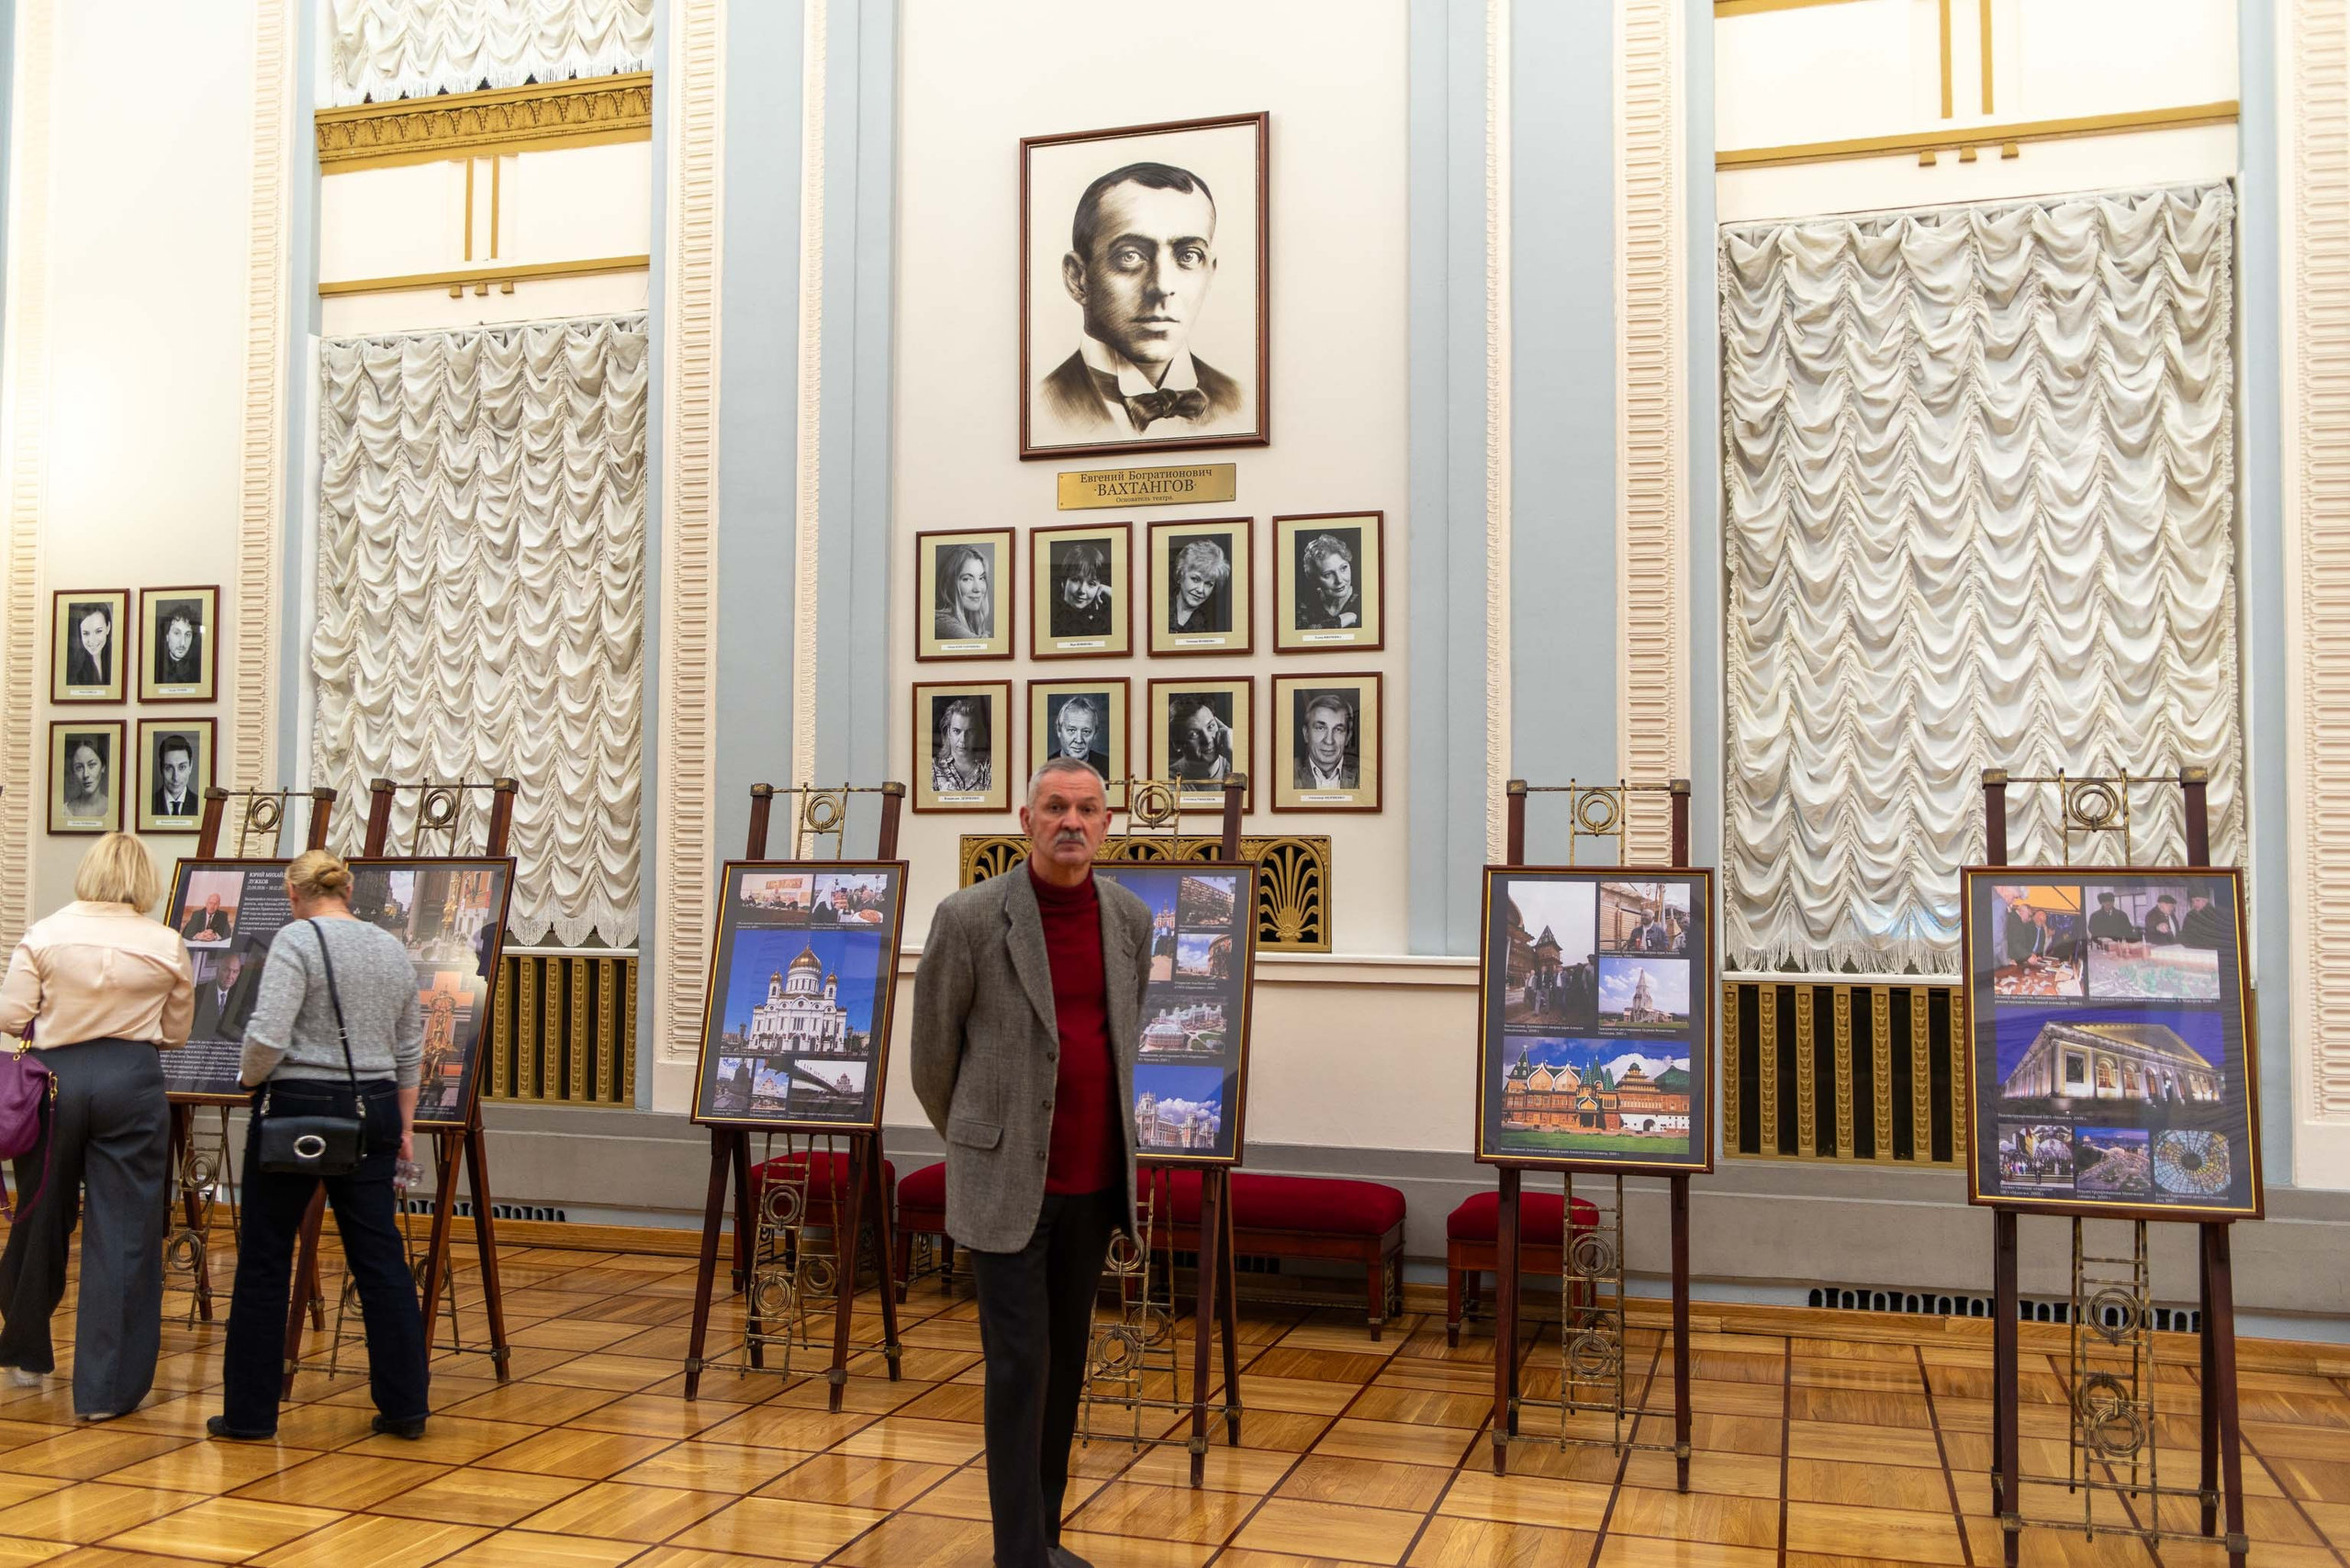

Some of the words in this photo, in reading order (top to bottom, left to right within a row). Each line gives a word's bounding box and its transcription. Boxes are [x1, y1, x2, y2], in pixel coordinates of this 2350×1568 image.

[1080, 471, 1125, 483] Евгений
[1129, 468, 1213, 482] Богратионович
[1097, 479, 1195, 497] ВАХТАНГОВ
